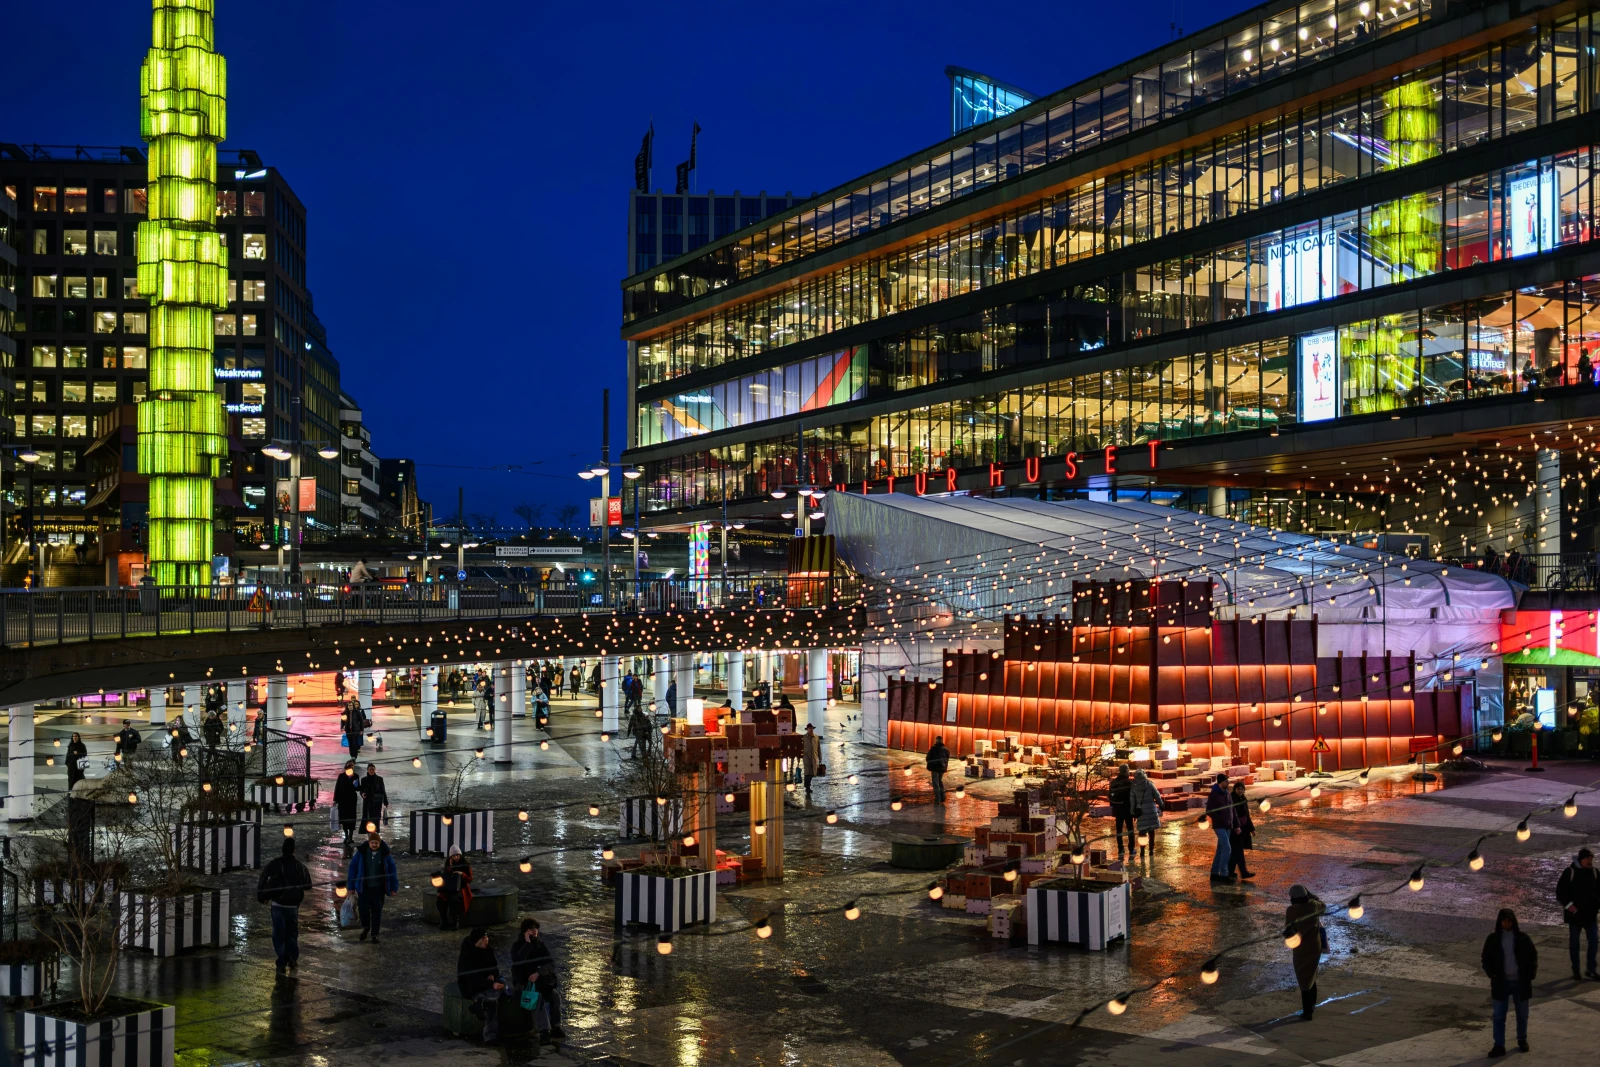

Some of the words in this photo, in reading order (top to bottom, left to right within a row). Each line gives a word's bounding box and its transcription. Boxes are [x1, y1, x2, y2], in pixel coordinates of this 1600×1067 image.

[1271, 242, 1298, 260] NICK
[1302, 232, 1336, 252] CAVE
[214, 367, 262, 378] Vasakronan
